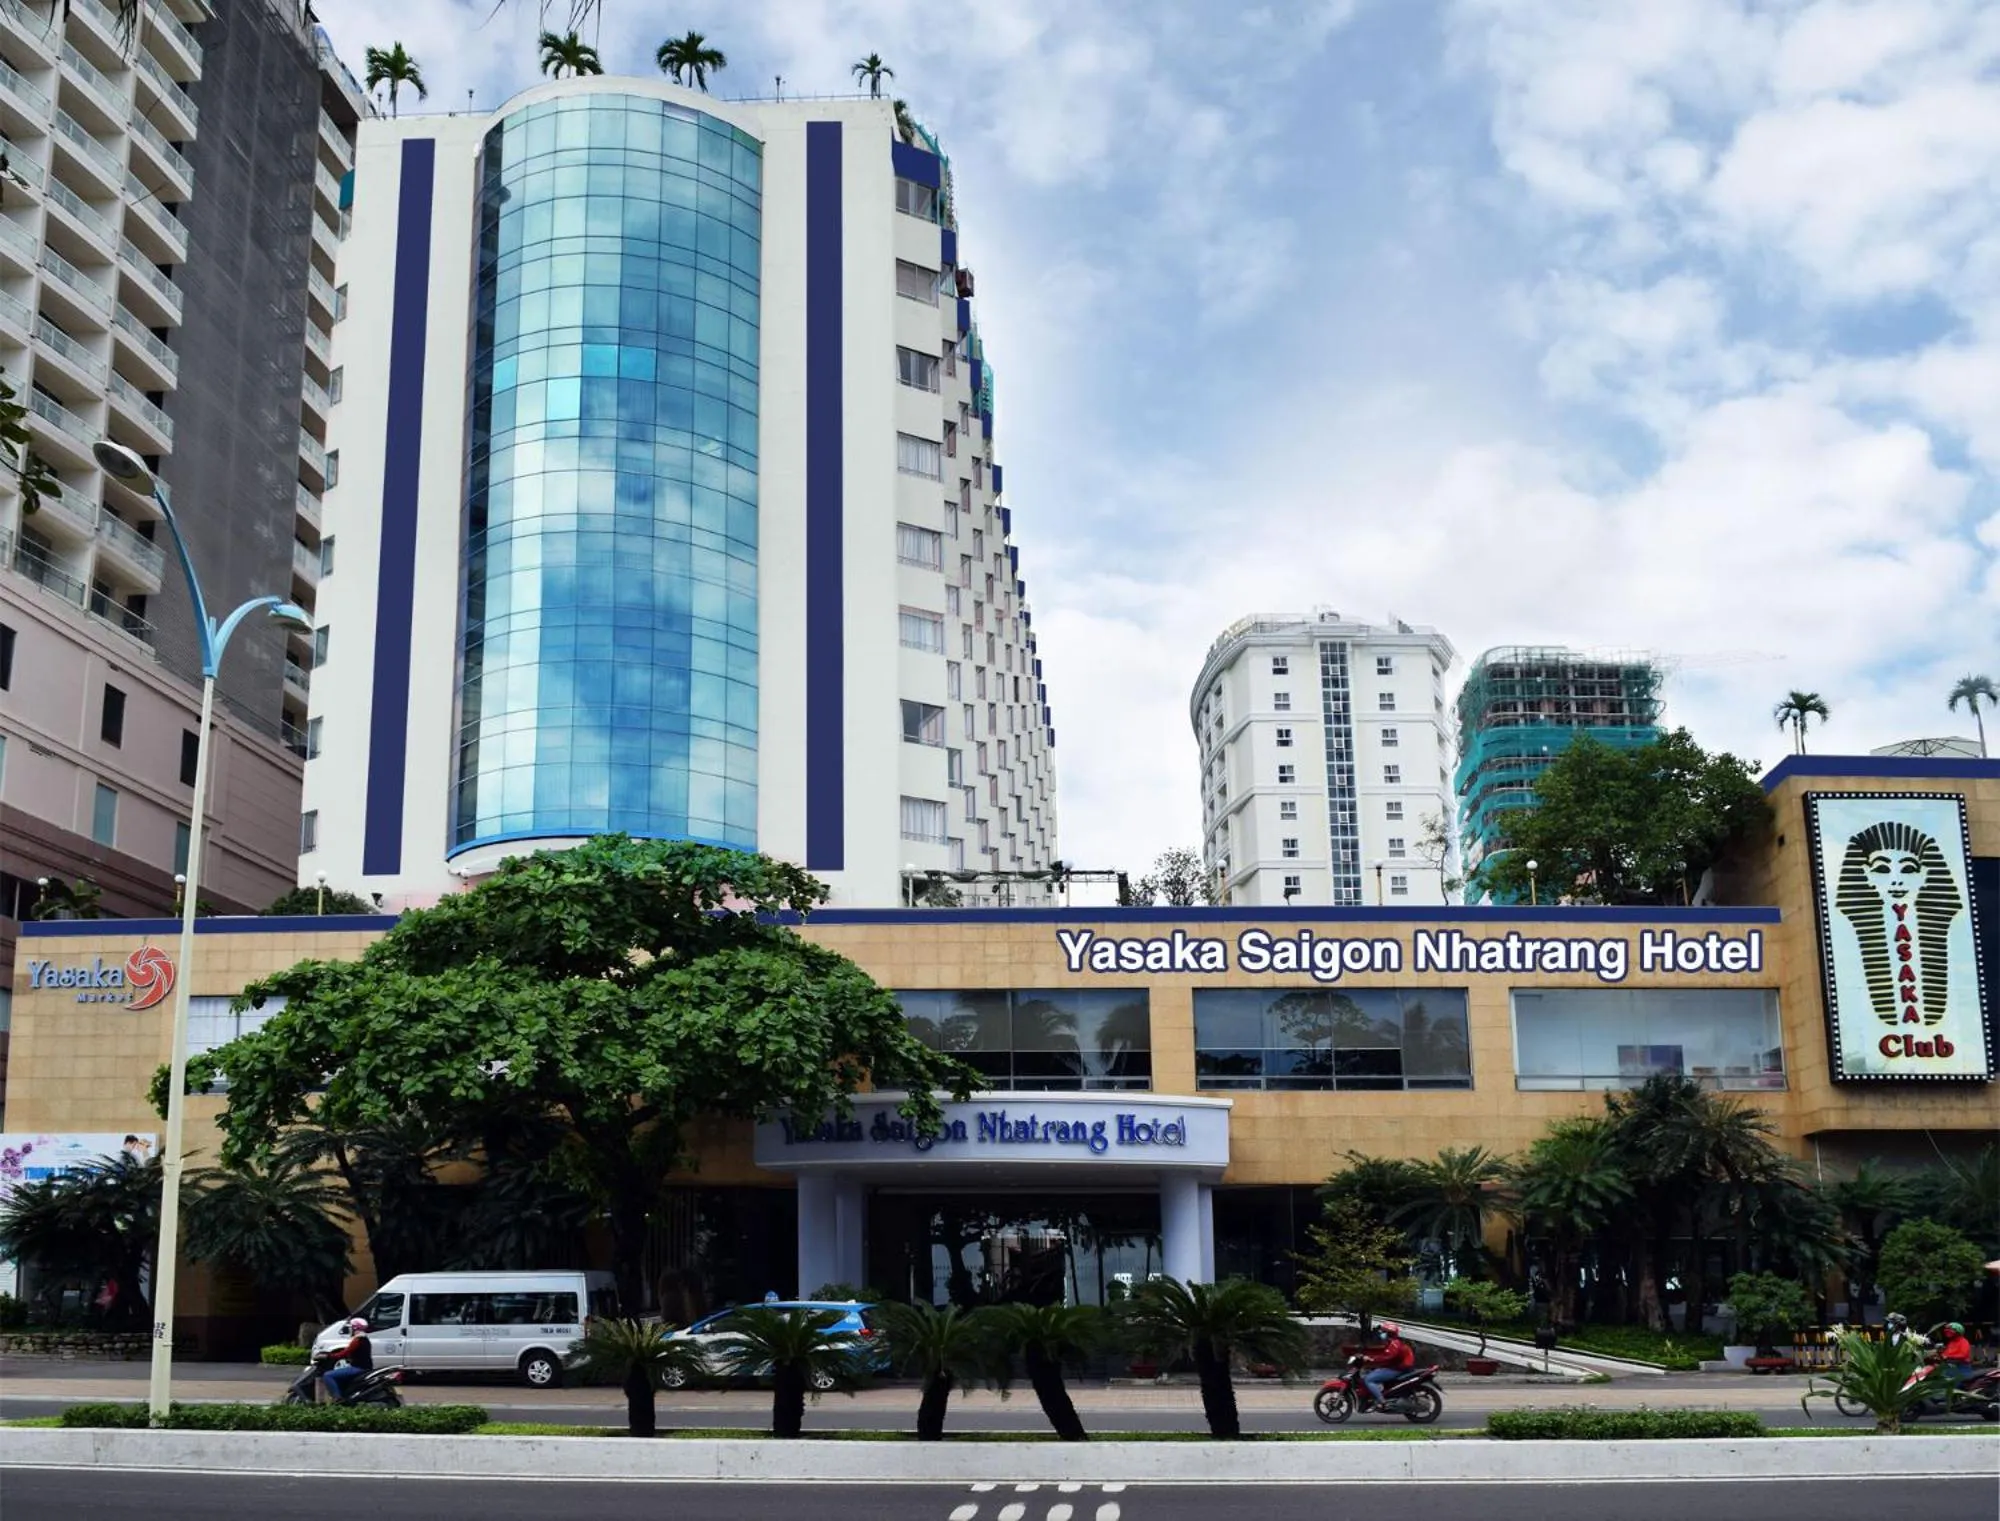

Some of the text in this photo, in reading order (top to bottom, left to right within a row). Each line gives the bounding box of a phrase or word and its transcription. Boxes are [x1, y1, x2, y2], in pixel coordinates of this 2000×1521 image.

[28, 958, 124, 988] Yasaka
[1056, 928, 1763, 982] Yasaka Saigon Nhatrang Hotel
[1891, 903, 1920, 1024] YASAKA
[77, 992, 134, 1003] Market
[1879, 1033, 1954, 1058] Club
[976, 1109, 1108, 1153] Nhatrang
[1115, 1113, 1186, 1146] Hotel
